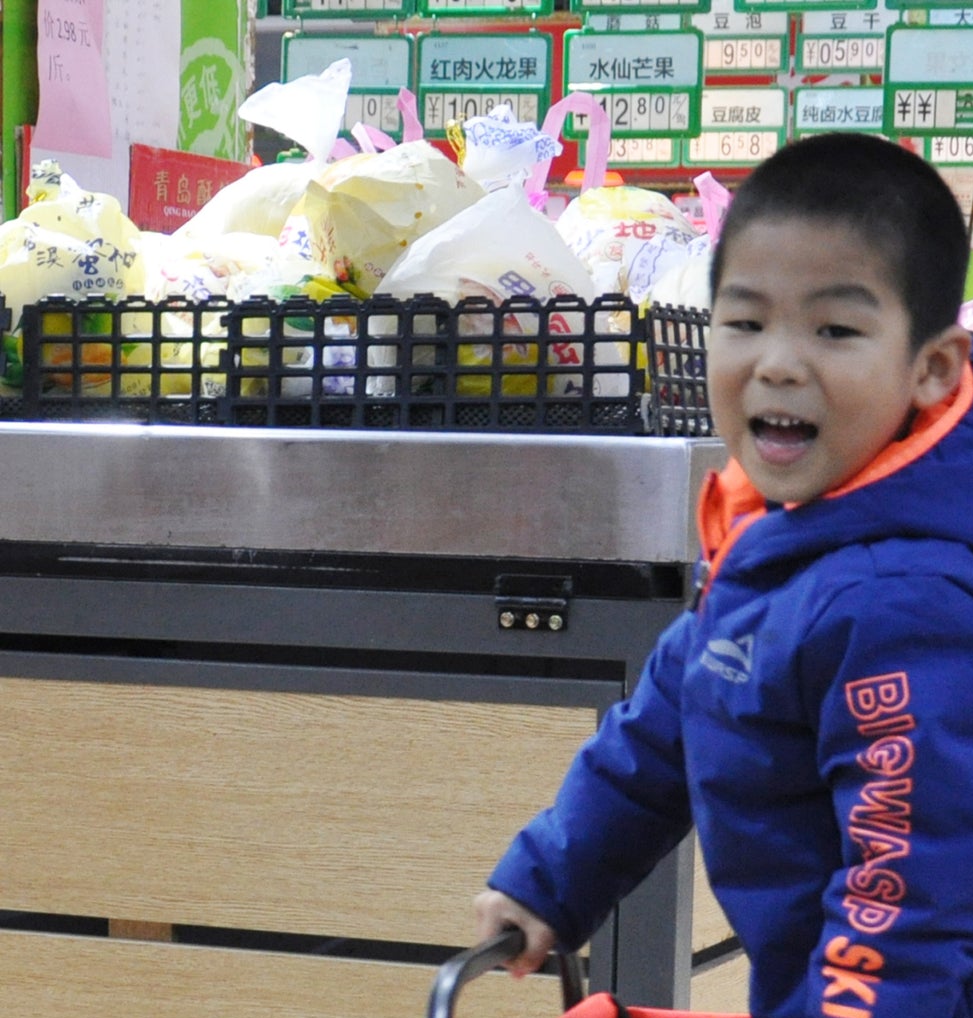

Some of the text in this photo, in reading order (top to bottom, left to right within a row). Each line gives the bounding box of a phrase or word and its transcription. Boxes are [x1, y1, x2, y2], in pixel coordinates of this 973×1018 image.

[430, 56, 538, 81] 红肉火龙果
[589, 56, 675, 81] 水仙芒果
[711, 105, 762, 124] 豆腐皮
[154, 169, 224, 206] 青岛酥
[845, 671, 917, 935] BIGWASP
